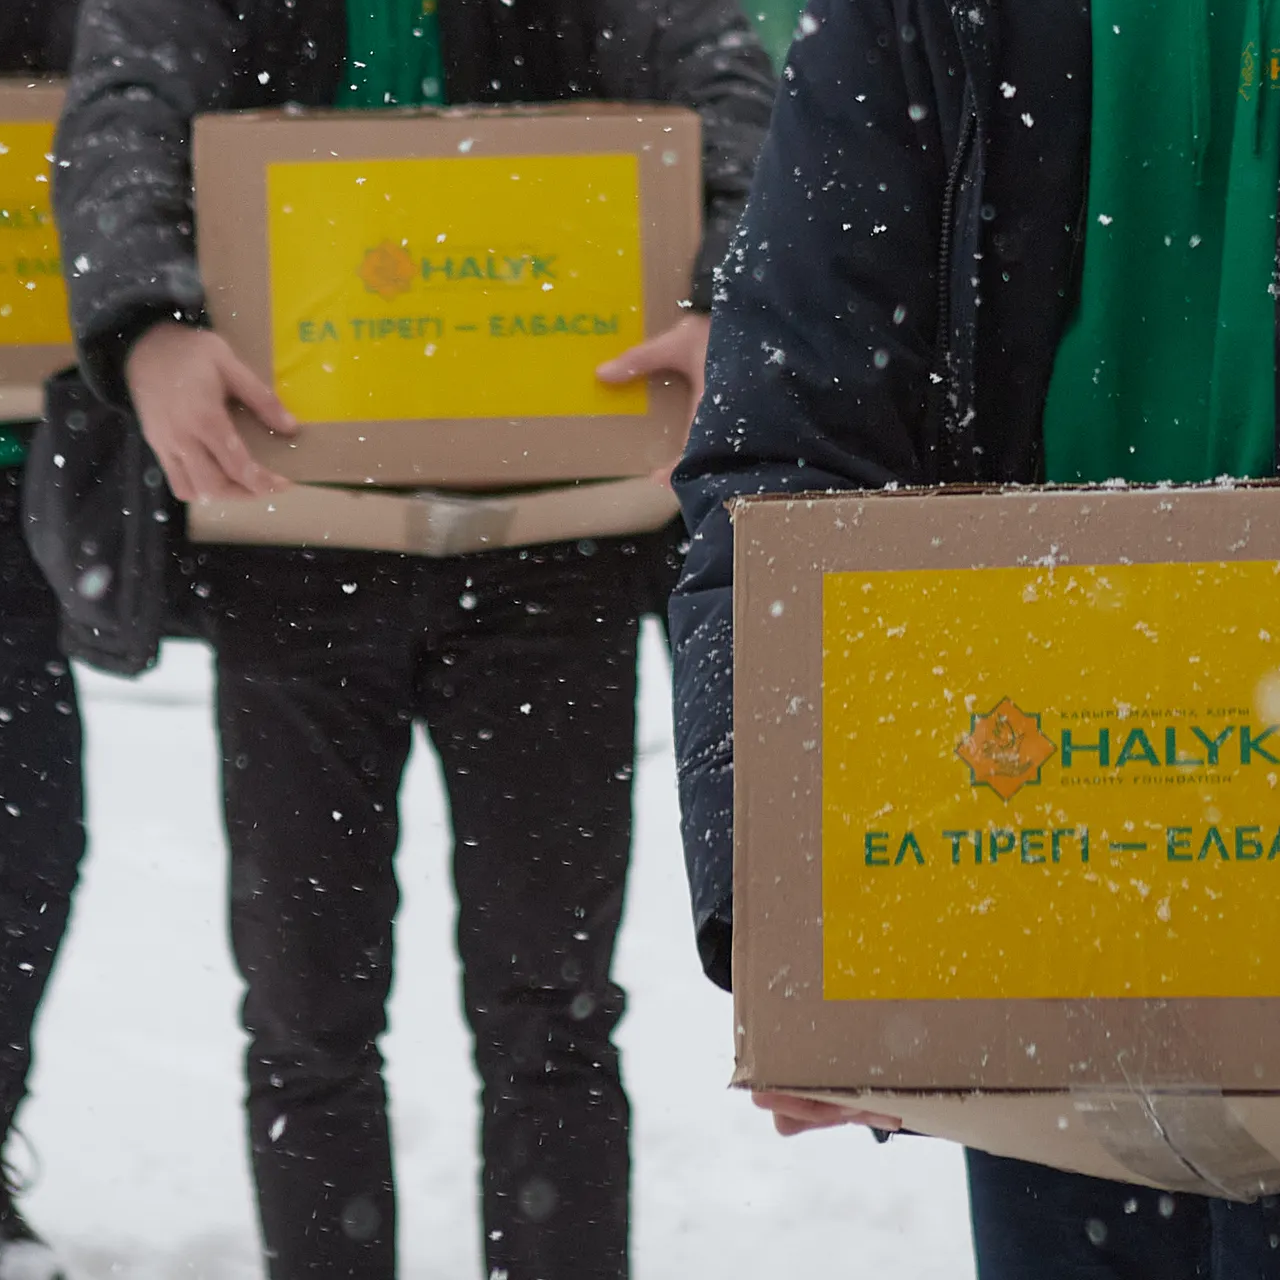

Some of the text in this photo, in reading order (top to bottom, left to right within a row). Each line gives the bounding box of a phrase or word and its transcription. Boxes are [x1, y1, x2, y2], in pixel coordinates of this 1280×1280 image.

[421, 255, 558, 281] HALYK
[488, 314, 618, 338] ЕЛБАСЫ
[864, 831, 926, 866] ЕЛ
[942, 827, 1090, 865] ТІРЕГІ
